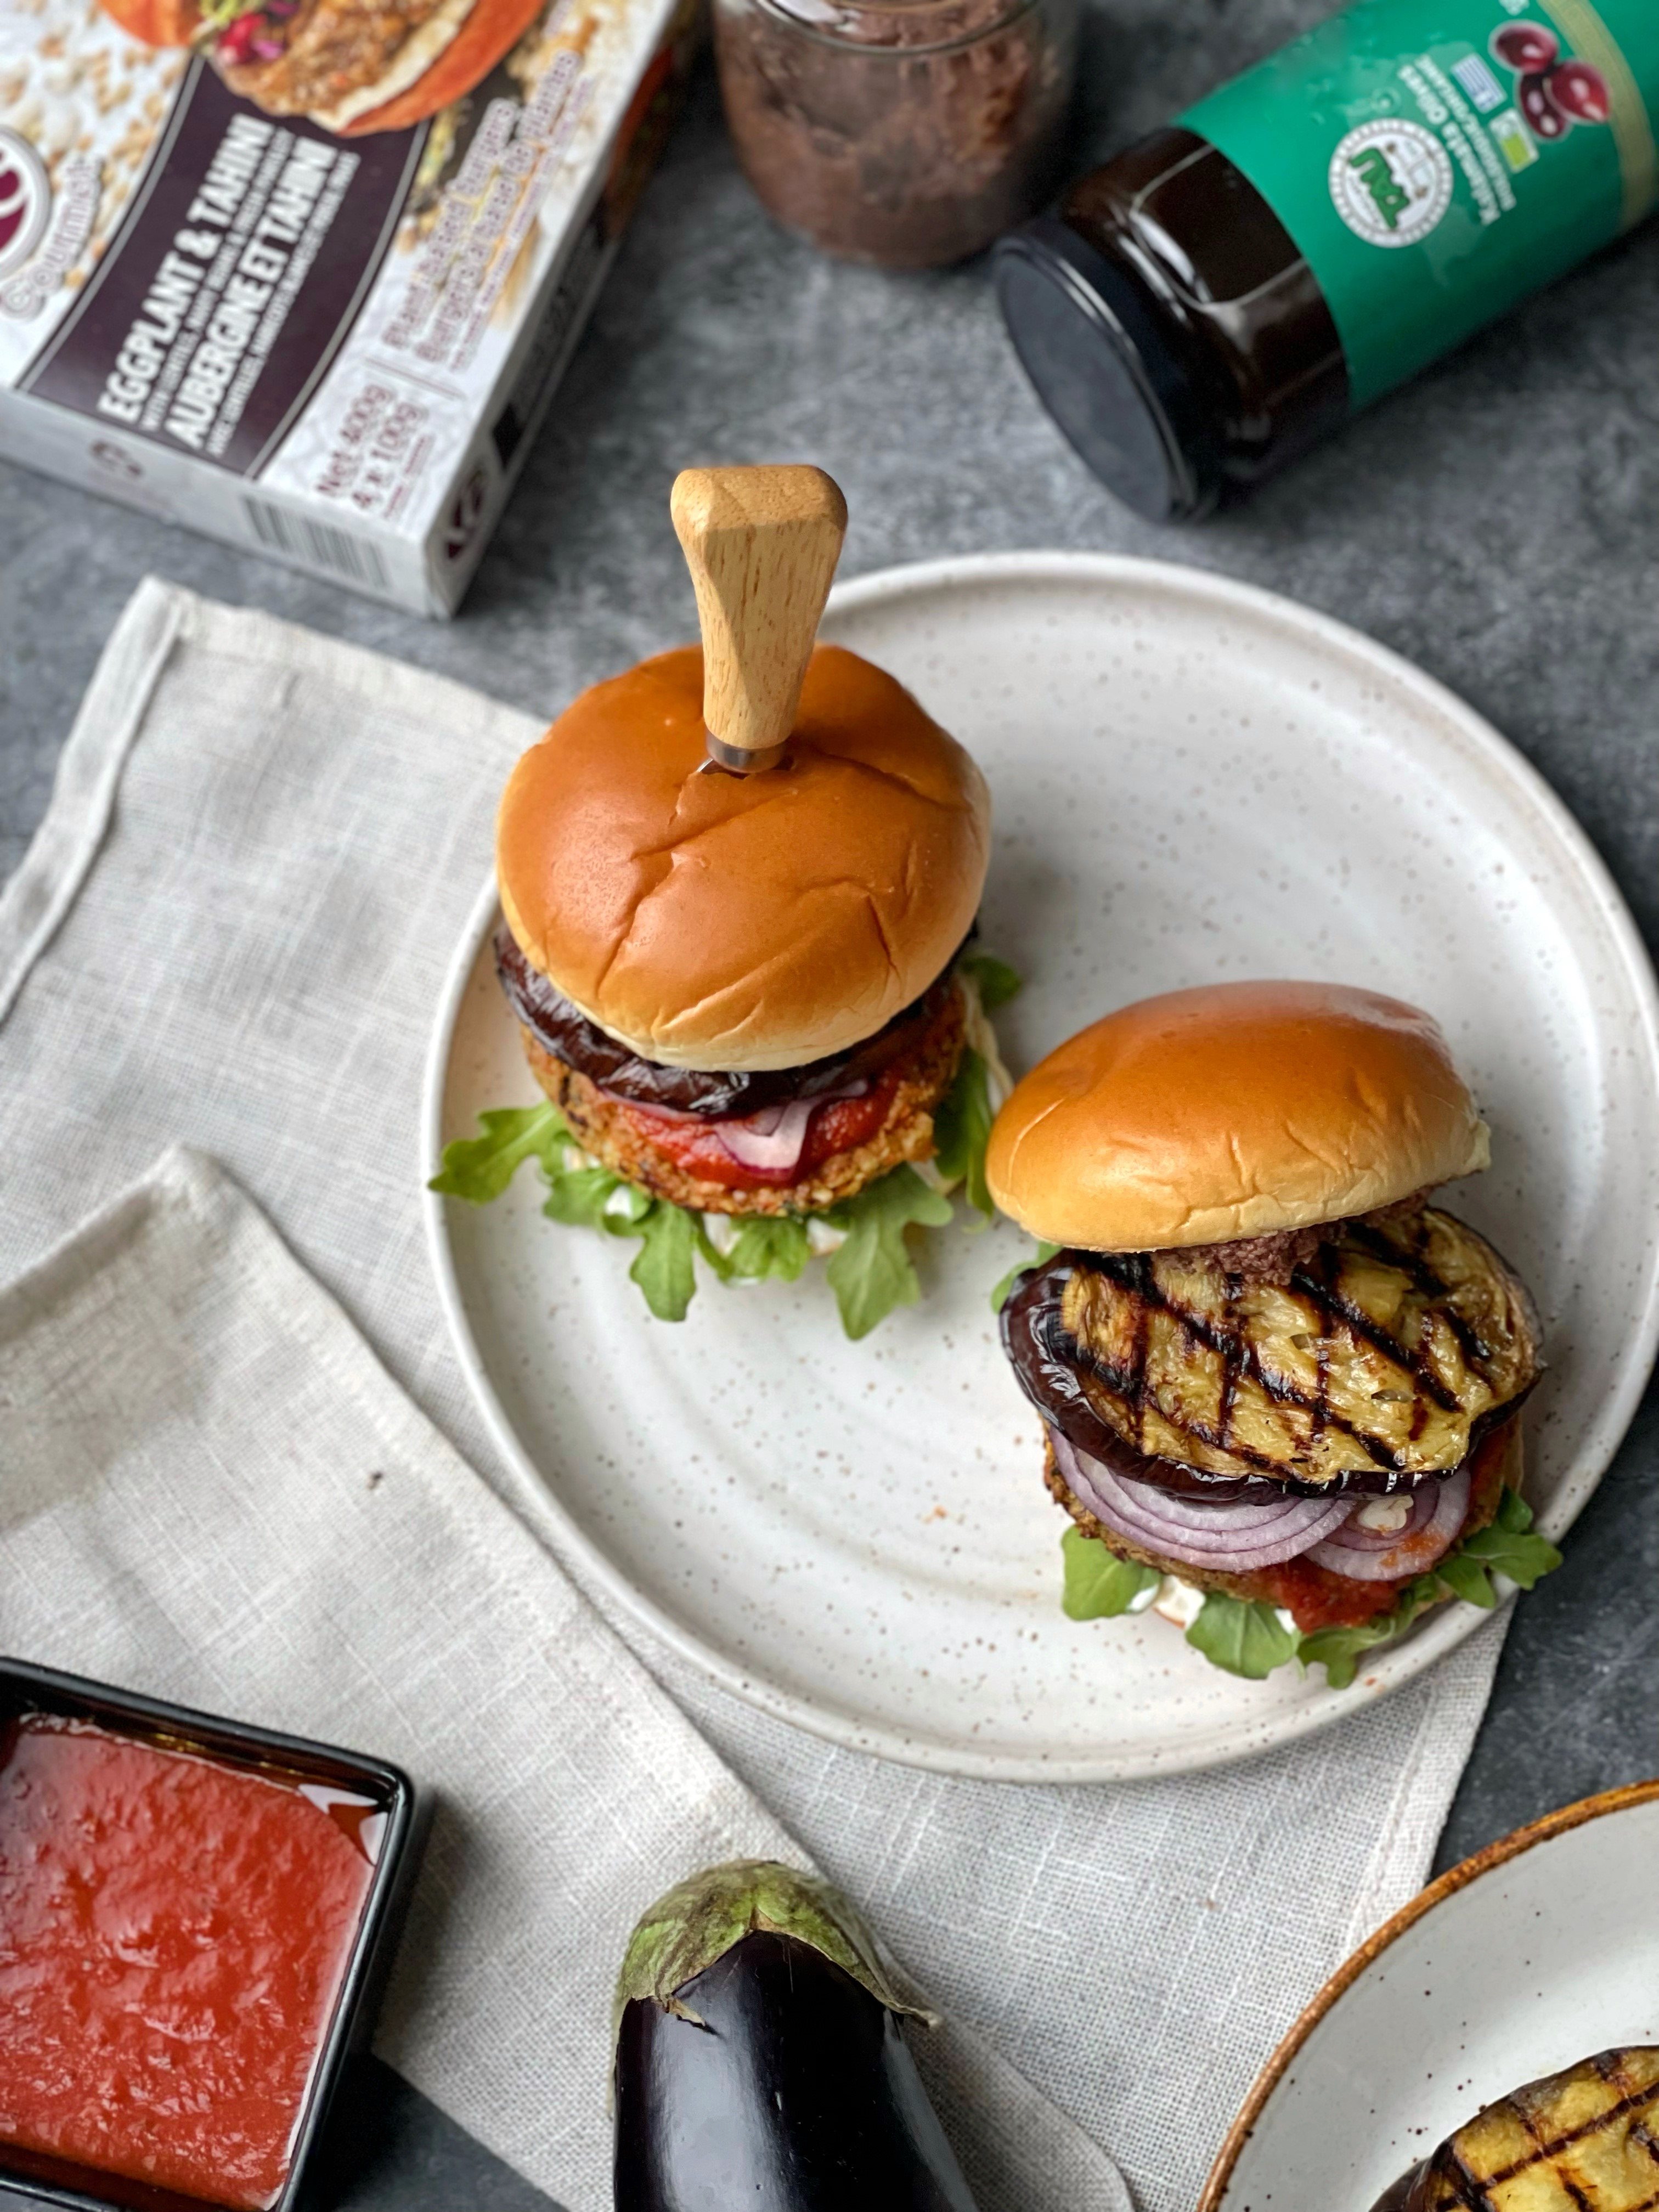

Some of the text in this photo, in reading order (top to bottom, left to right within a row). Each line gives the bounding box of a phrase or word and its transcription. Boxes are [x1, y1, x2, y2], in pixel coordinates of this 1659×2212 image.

[184, 110, 276, 232] TAHINI
[162, 134, 338, 449] AUBERGINE ET TAHINI
[171, 218, 223, 263] &
[95, 248, 206, 422] EGGPLANT
[336, 380, 390, 447] 400g
[348, 489, 374, 510] 4
[369, 396, 422, 462] 100g
